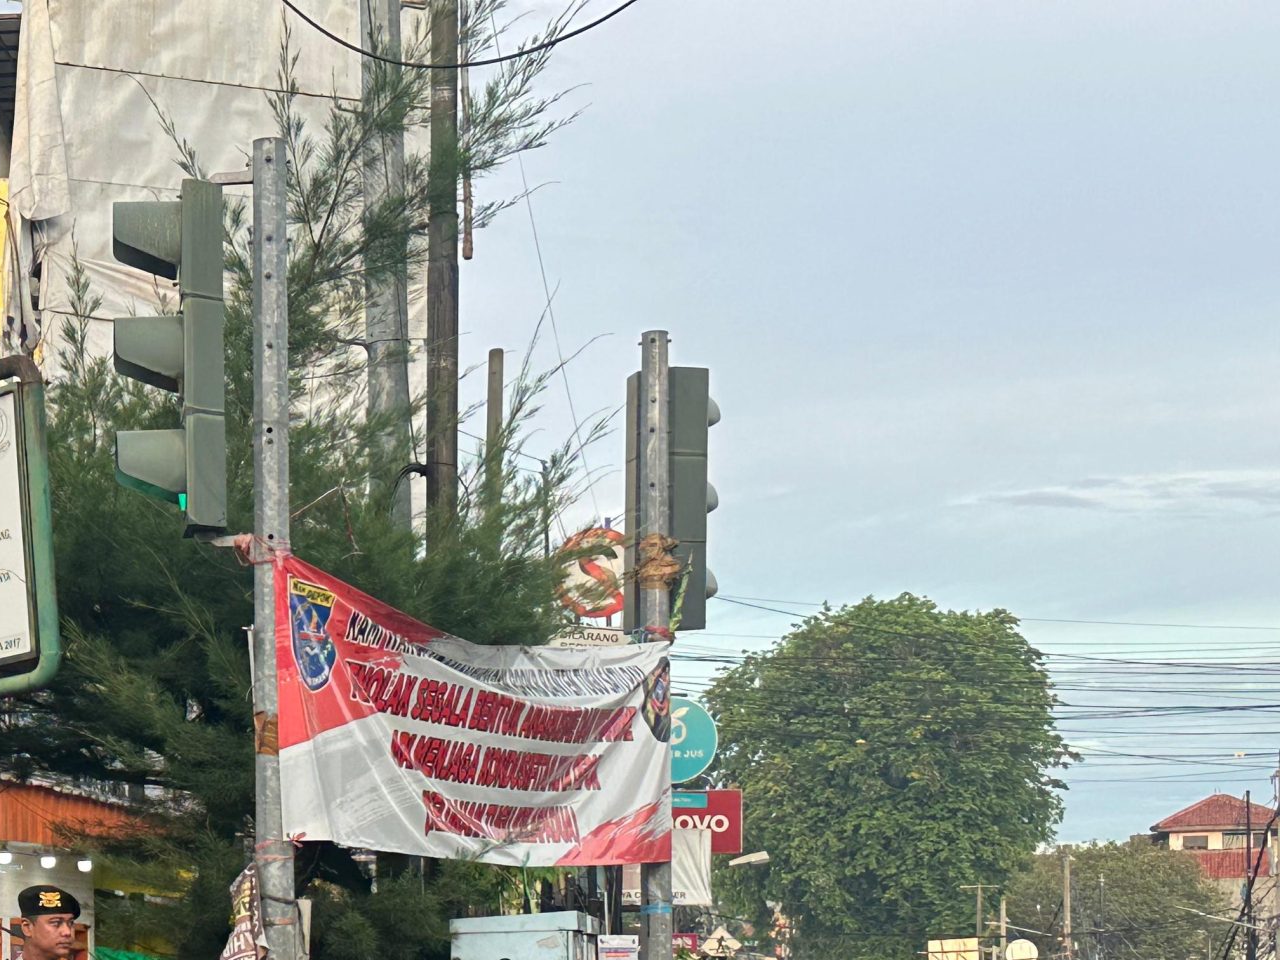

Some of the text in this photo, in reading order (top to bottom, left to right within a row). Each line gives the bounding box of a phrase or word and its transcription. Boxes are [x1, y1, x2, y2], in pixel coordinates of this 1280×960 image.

[4, 637, 22, 651] 2017
[412, 676, 473, 730] SEGALA
[683, 749, 705, 759] JUS
[671, 814, 730, 833] ovo
